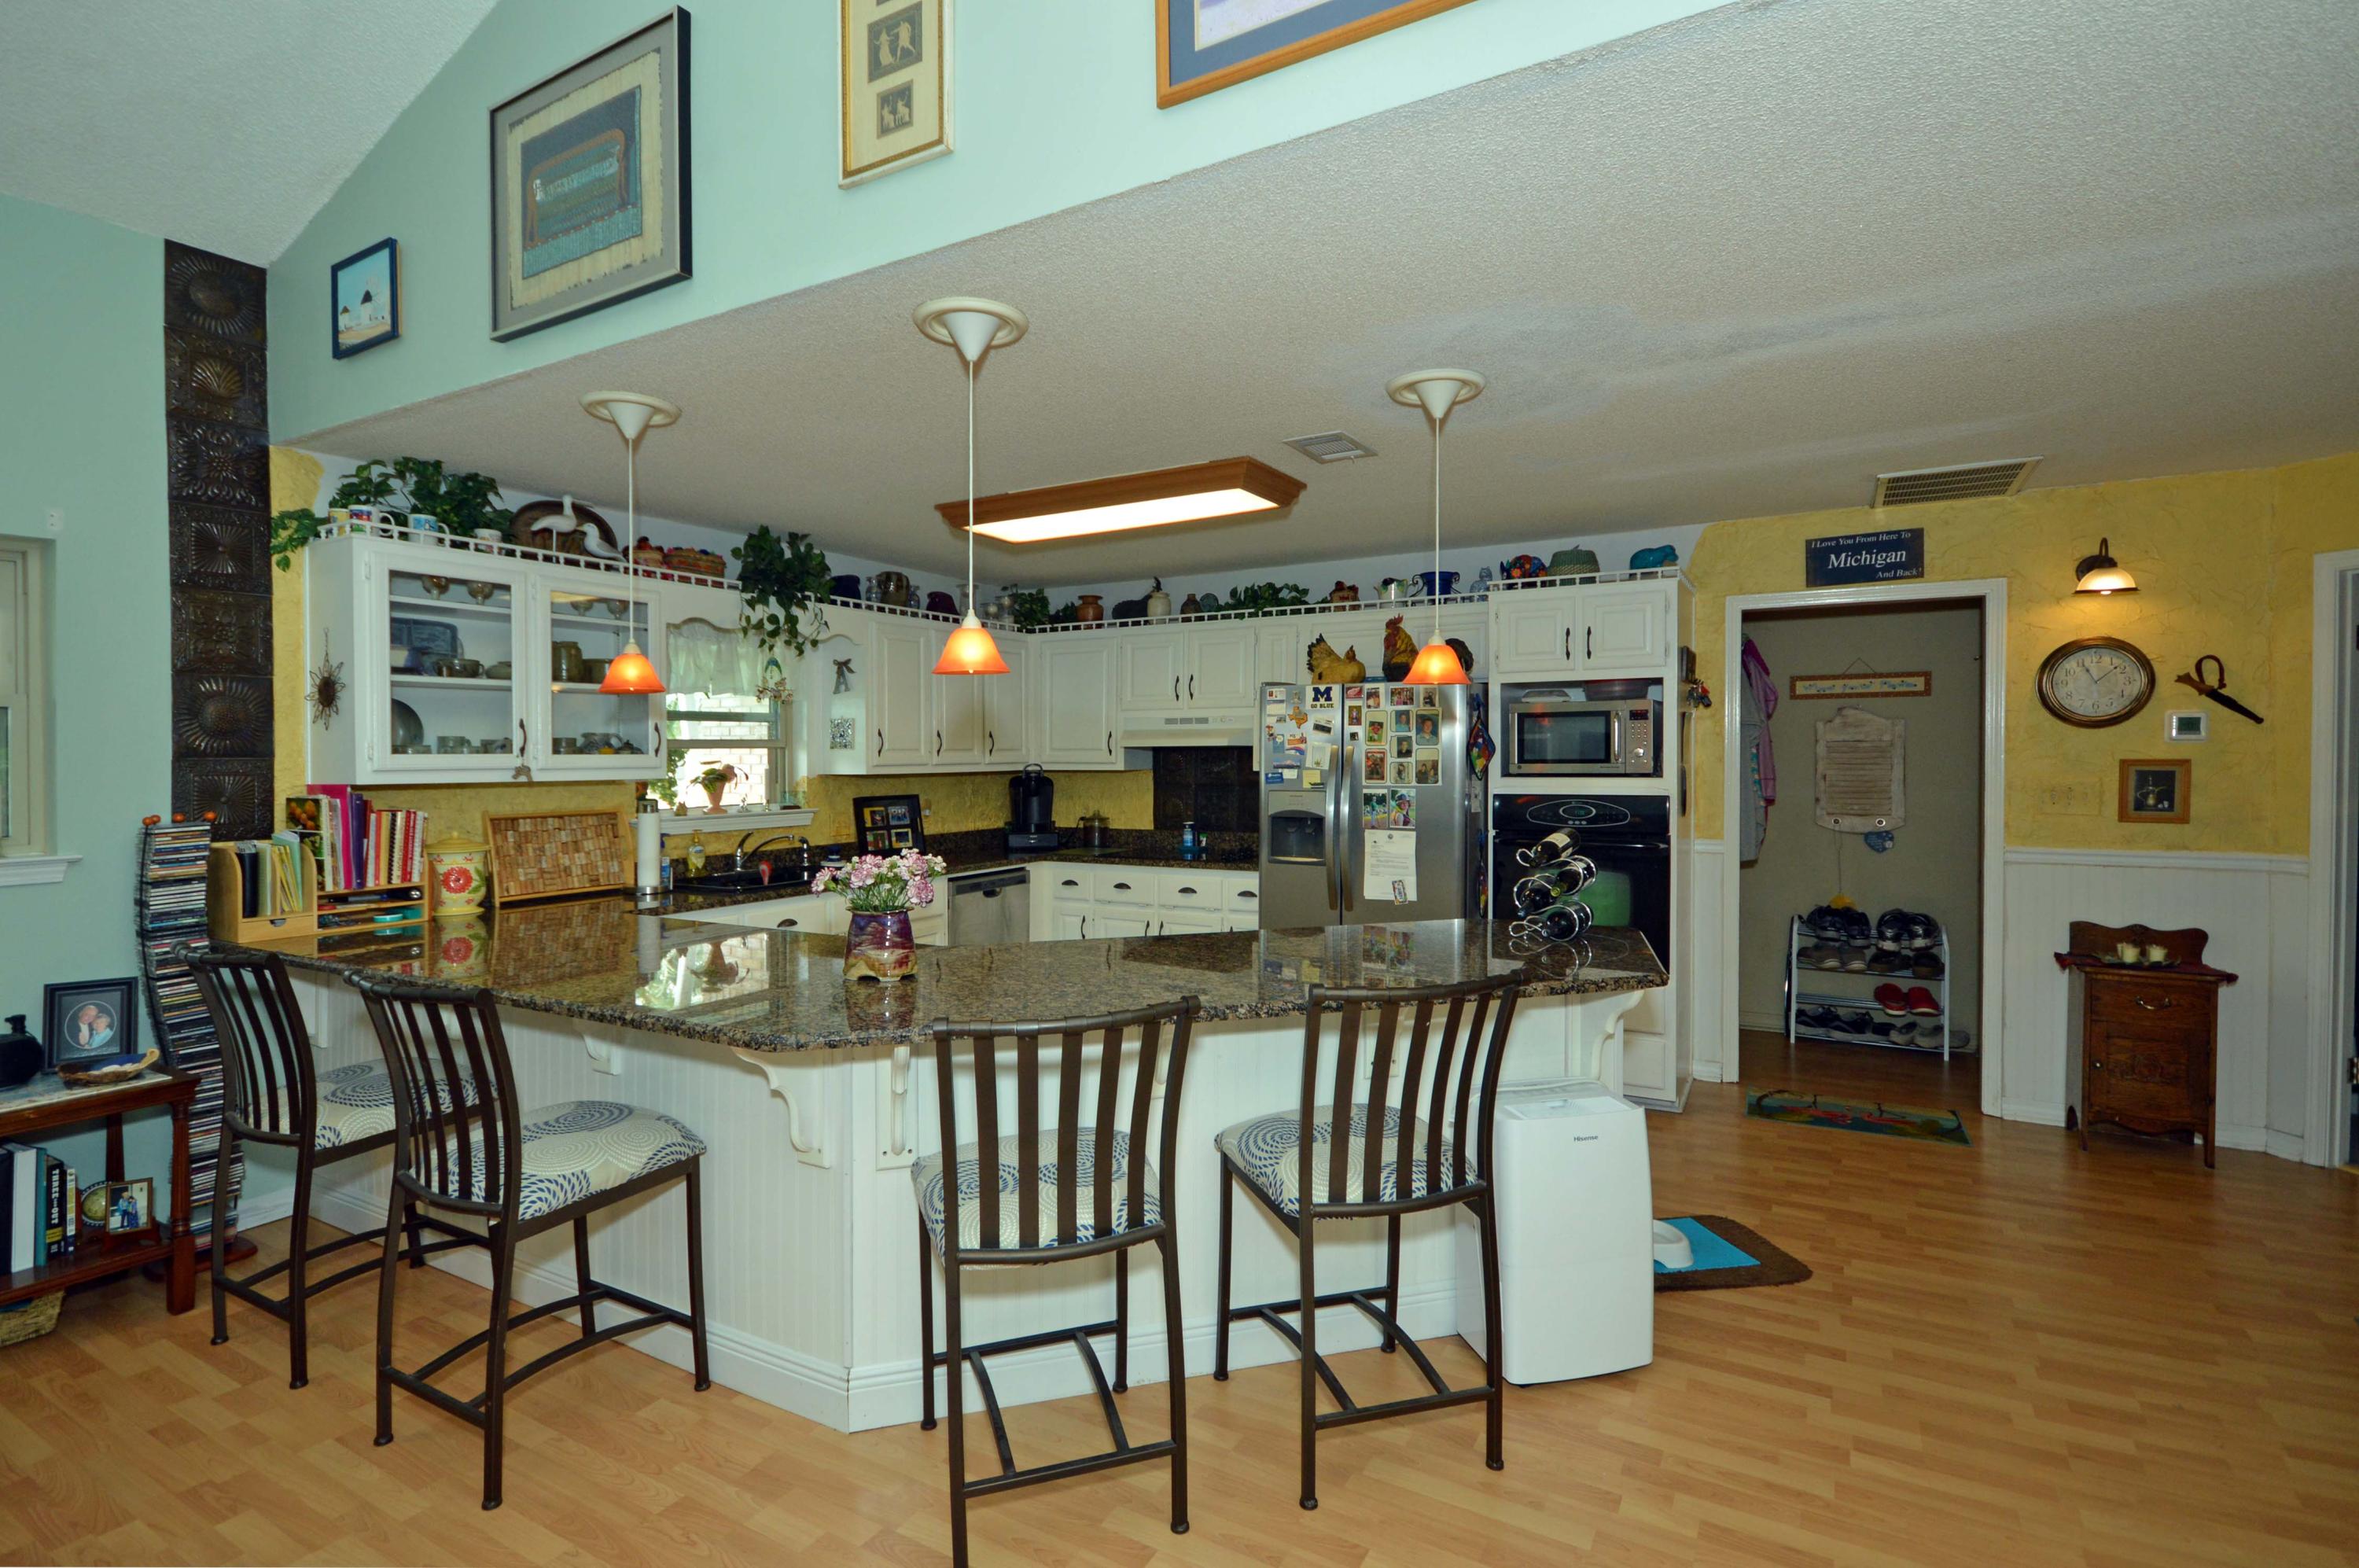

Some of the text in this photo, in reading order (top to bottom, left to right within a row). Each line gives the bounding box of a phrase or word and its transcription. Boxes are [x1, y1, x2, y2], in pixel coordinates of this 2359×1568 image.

[1827, 550, 1907, 569] Michigan
[1875, 568, 1923, 579] And Back!
[2089, 654, 2103, 664] 12
[2109, 657, 2114, 666] 1
[2118, 665, 2127, 675] 2
[2060, 679, 2069, 688] 9
[2123, 676, 2132, 686] 3
[1312, 686, 1333, 702] M
[2065, 691, 2074, 700] 8
[2078, 699, 2085, 708] 7
[2092, 700, 2100, 710] 6
[2105, 698, 2114, 707] 5
[51, 1169, 60, 1199] THREE
